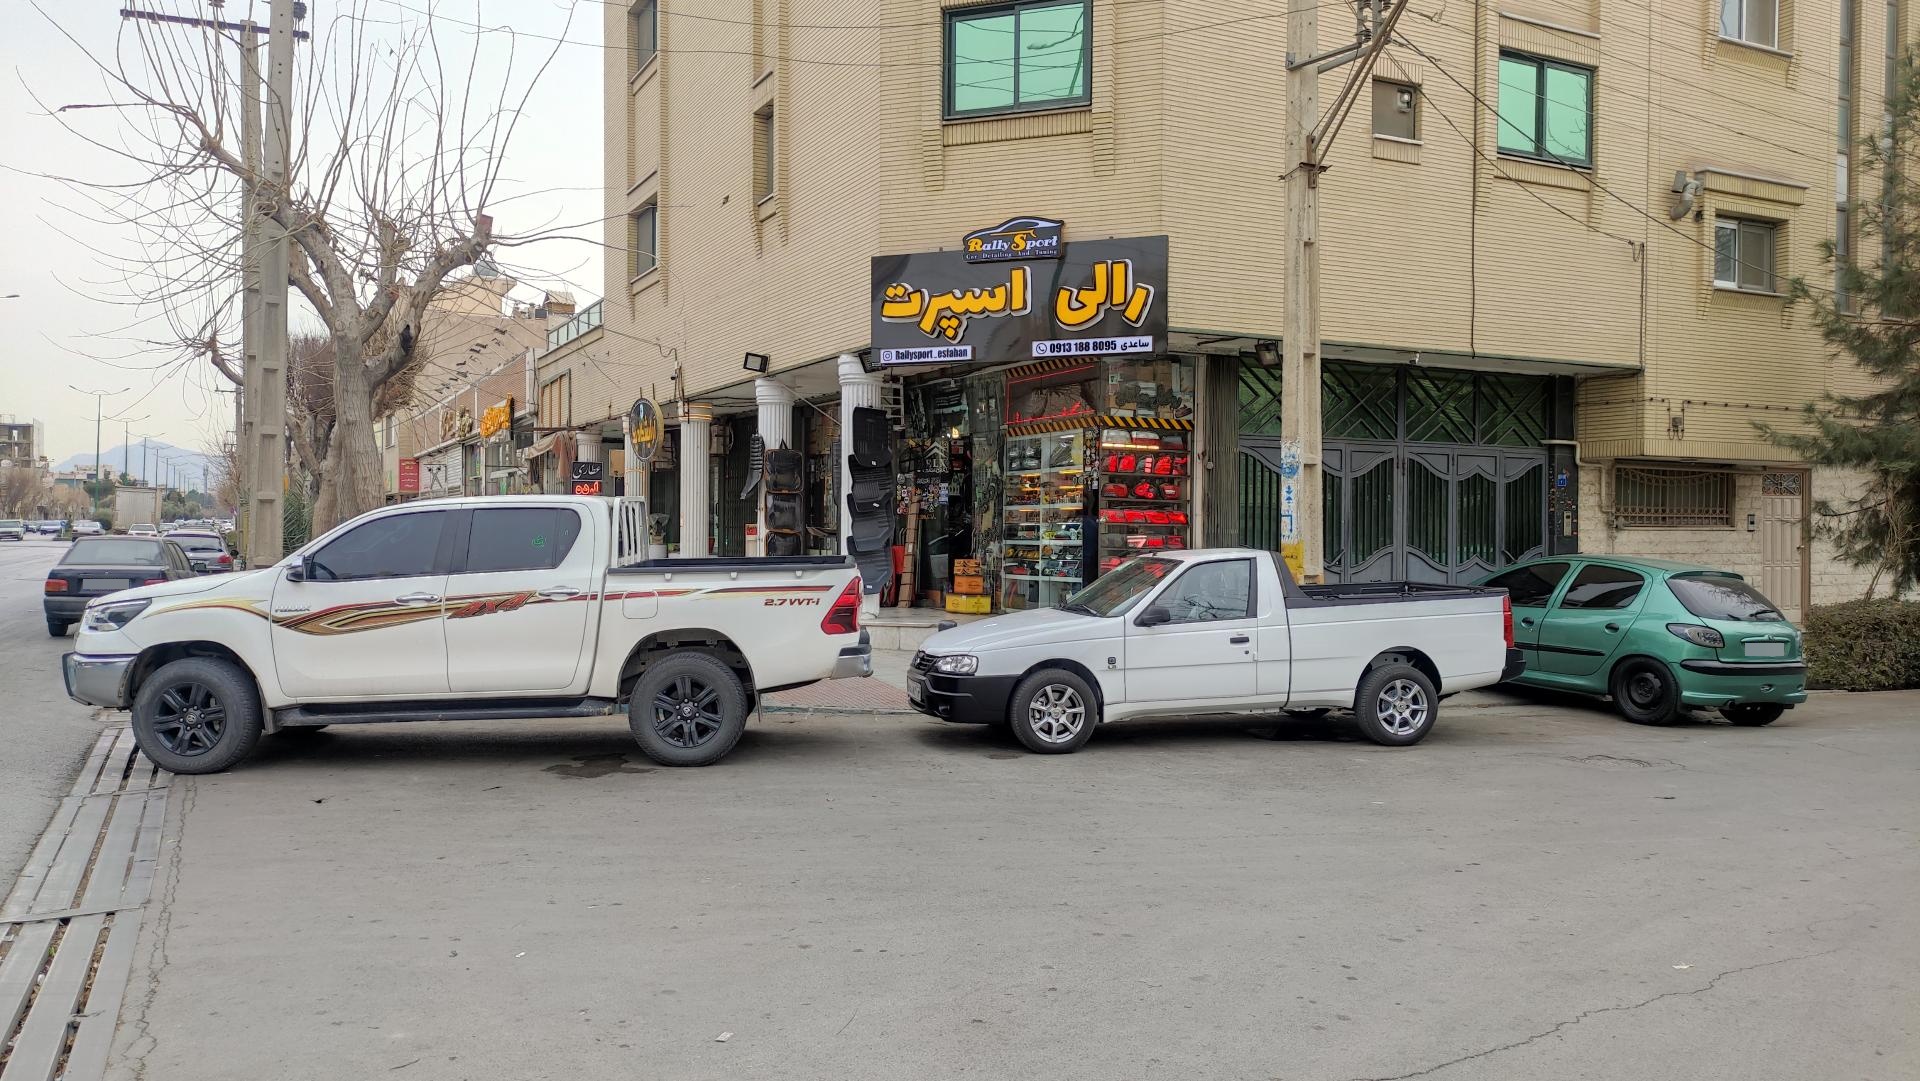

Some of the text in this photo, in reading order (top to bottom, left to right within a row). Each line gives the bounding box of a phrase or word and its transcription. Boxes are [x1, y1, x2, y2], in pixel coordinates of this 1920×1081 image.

[968, 233, 1058, 251] Rally Sport
[881, 260, 1153, 342] رالی اسپرت
[1050, 339, 1150, 353] 0913 188 8095 ساعدی
[573, 463, 600, 479] عطاری
[764, 598, 787, 606] 2.7
